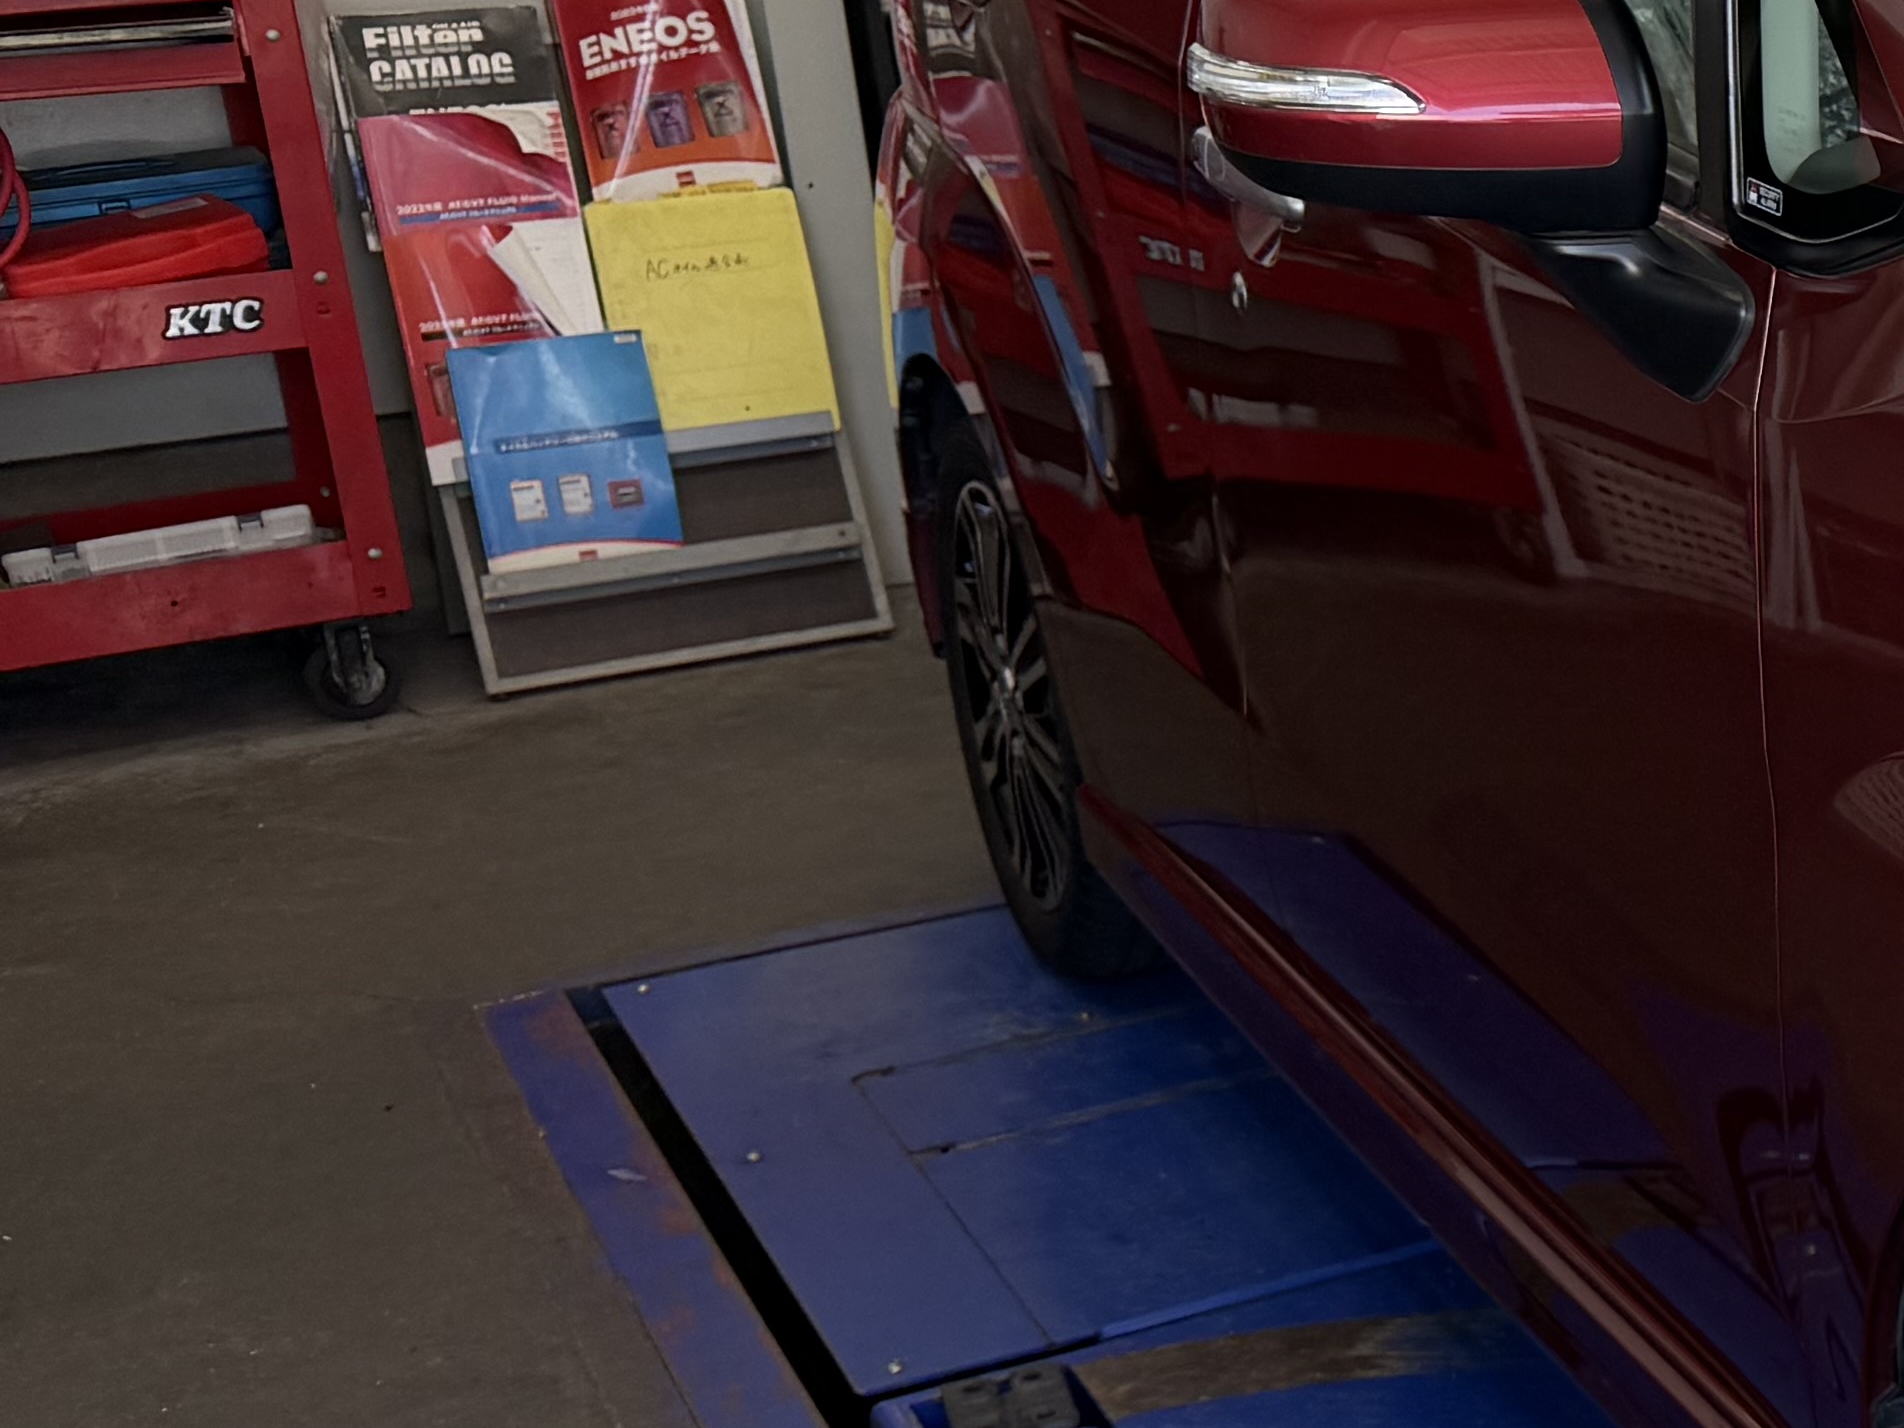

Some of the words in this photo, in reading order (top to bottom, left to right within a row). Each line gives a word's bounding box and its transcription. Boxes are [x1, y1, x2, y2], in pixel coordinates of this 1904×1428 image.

[578, 10, 716, 68] ENEOS
[369, 51, 517, 92] CATALOG
[165, 299, 261, 338] KTC
